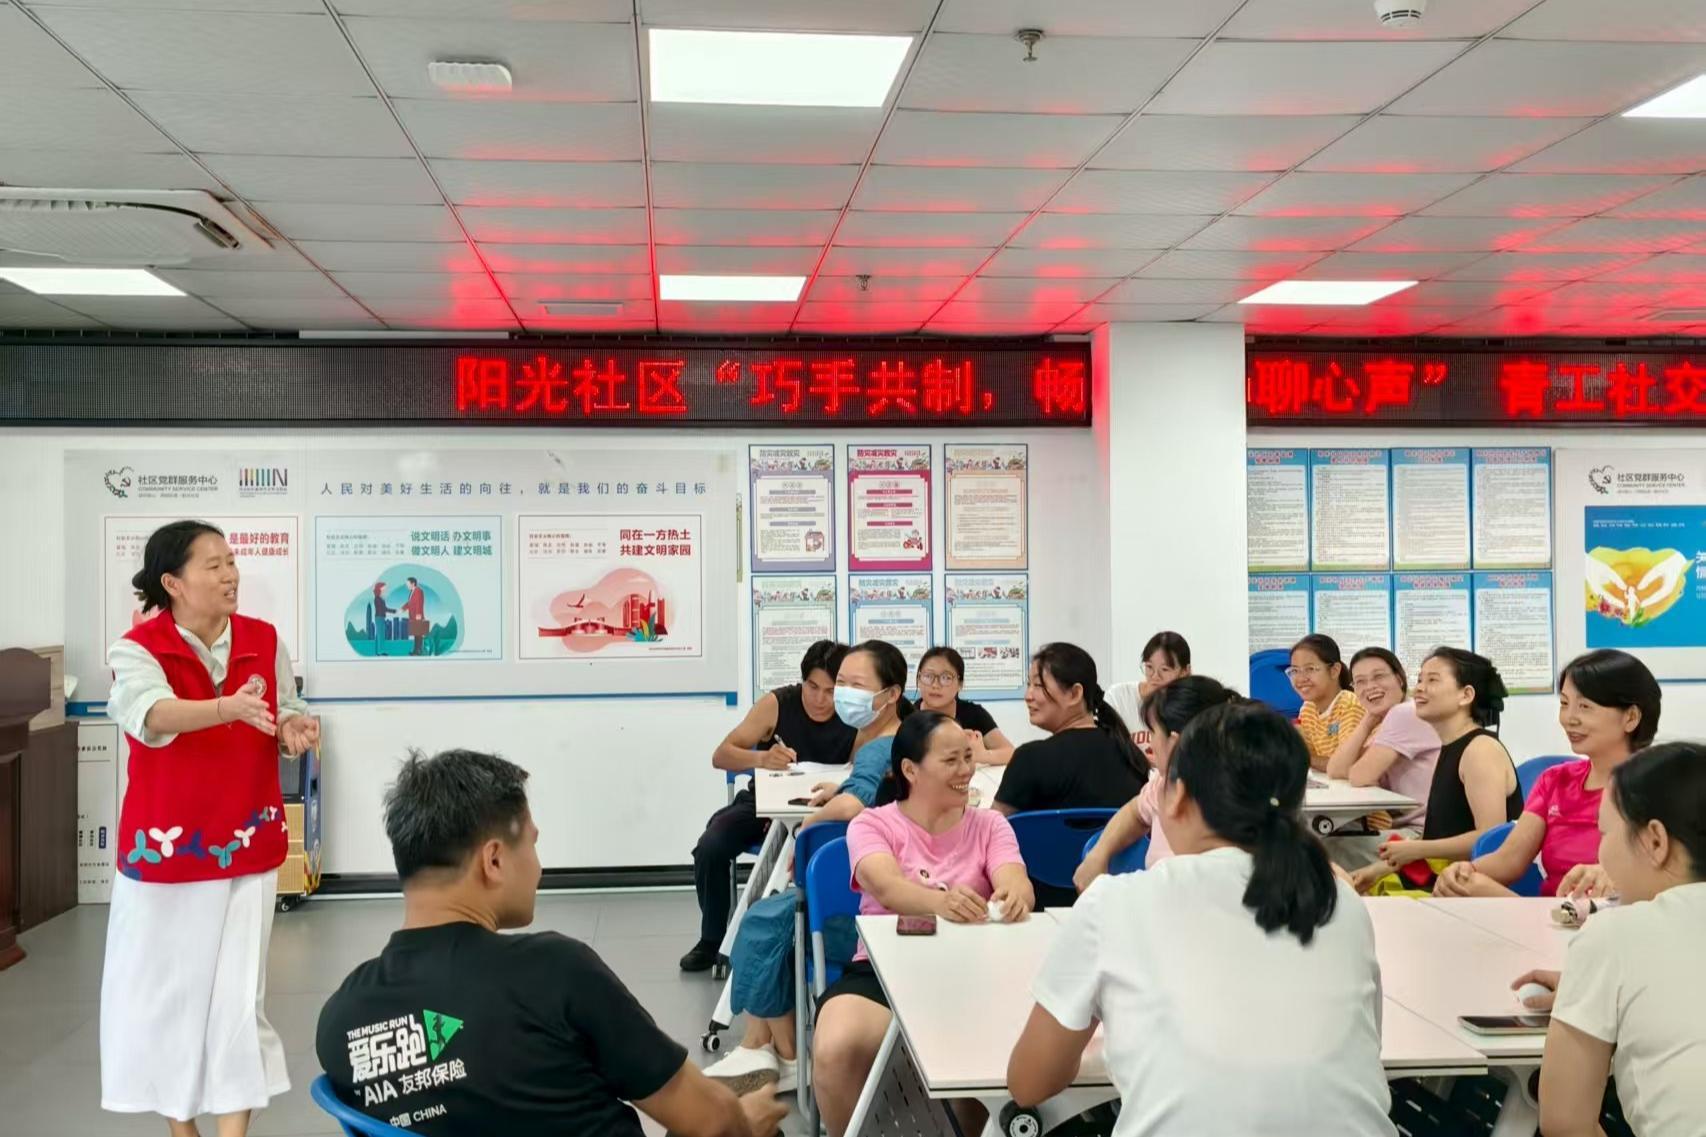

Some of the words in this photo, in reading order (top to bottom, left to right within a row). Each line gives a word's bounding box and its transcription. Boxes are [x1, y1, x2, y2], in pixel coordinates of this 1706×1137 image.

[138, 475, 218, 485] 社区党群服务中心
[320, 481, 707, 496] 人民对美好生活的向往，就是我们的奋斗目标
[229, 532, 289, 545] 是最好的教育
[410, 531, 449, 542] 说文明话
[452, 531, 491, 542] 办文明事
[619, 529, 691, 541] 同在一方热土
[411, 545, 450, 556] 做文明人
[453, 545, 493, 556] 建文明城
[620, 544, 692, 556] 共建文明家园
[346, 1030, 361, 1041] THE
[360, 1021, 389, 1036] MUSIC
[389, 1016, 408, 1029] RUN
[364, 1079, 399, 1107] AIA
[397, 1057, 468, 1095] 友邦保险
[389, 1112, 412, 1128] 中国
[412, 1103, 448, 1122] CHINA
